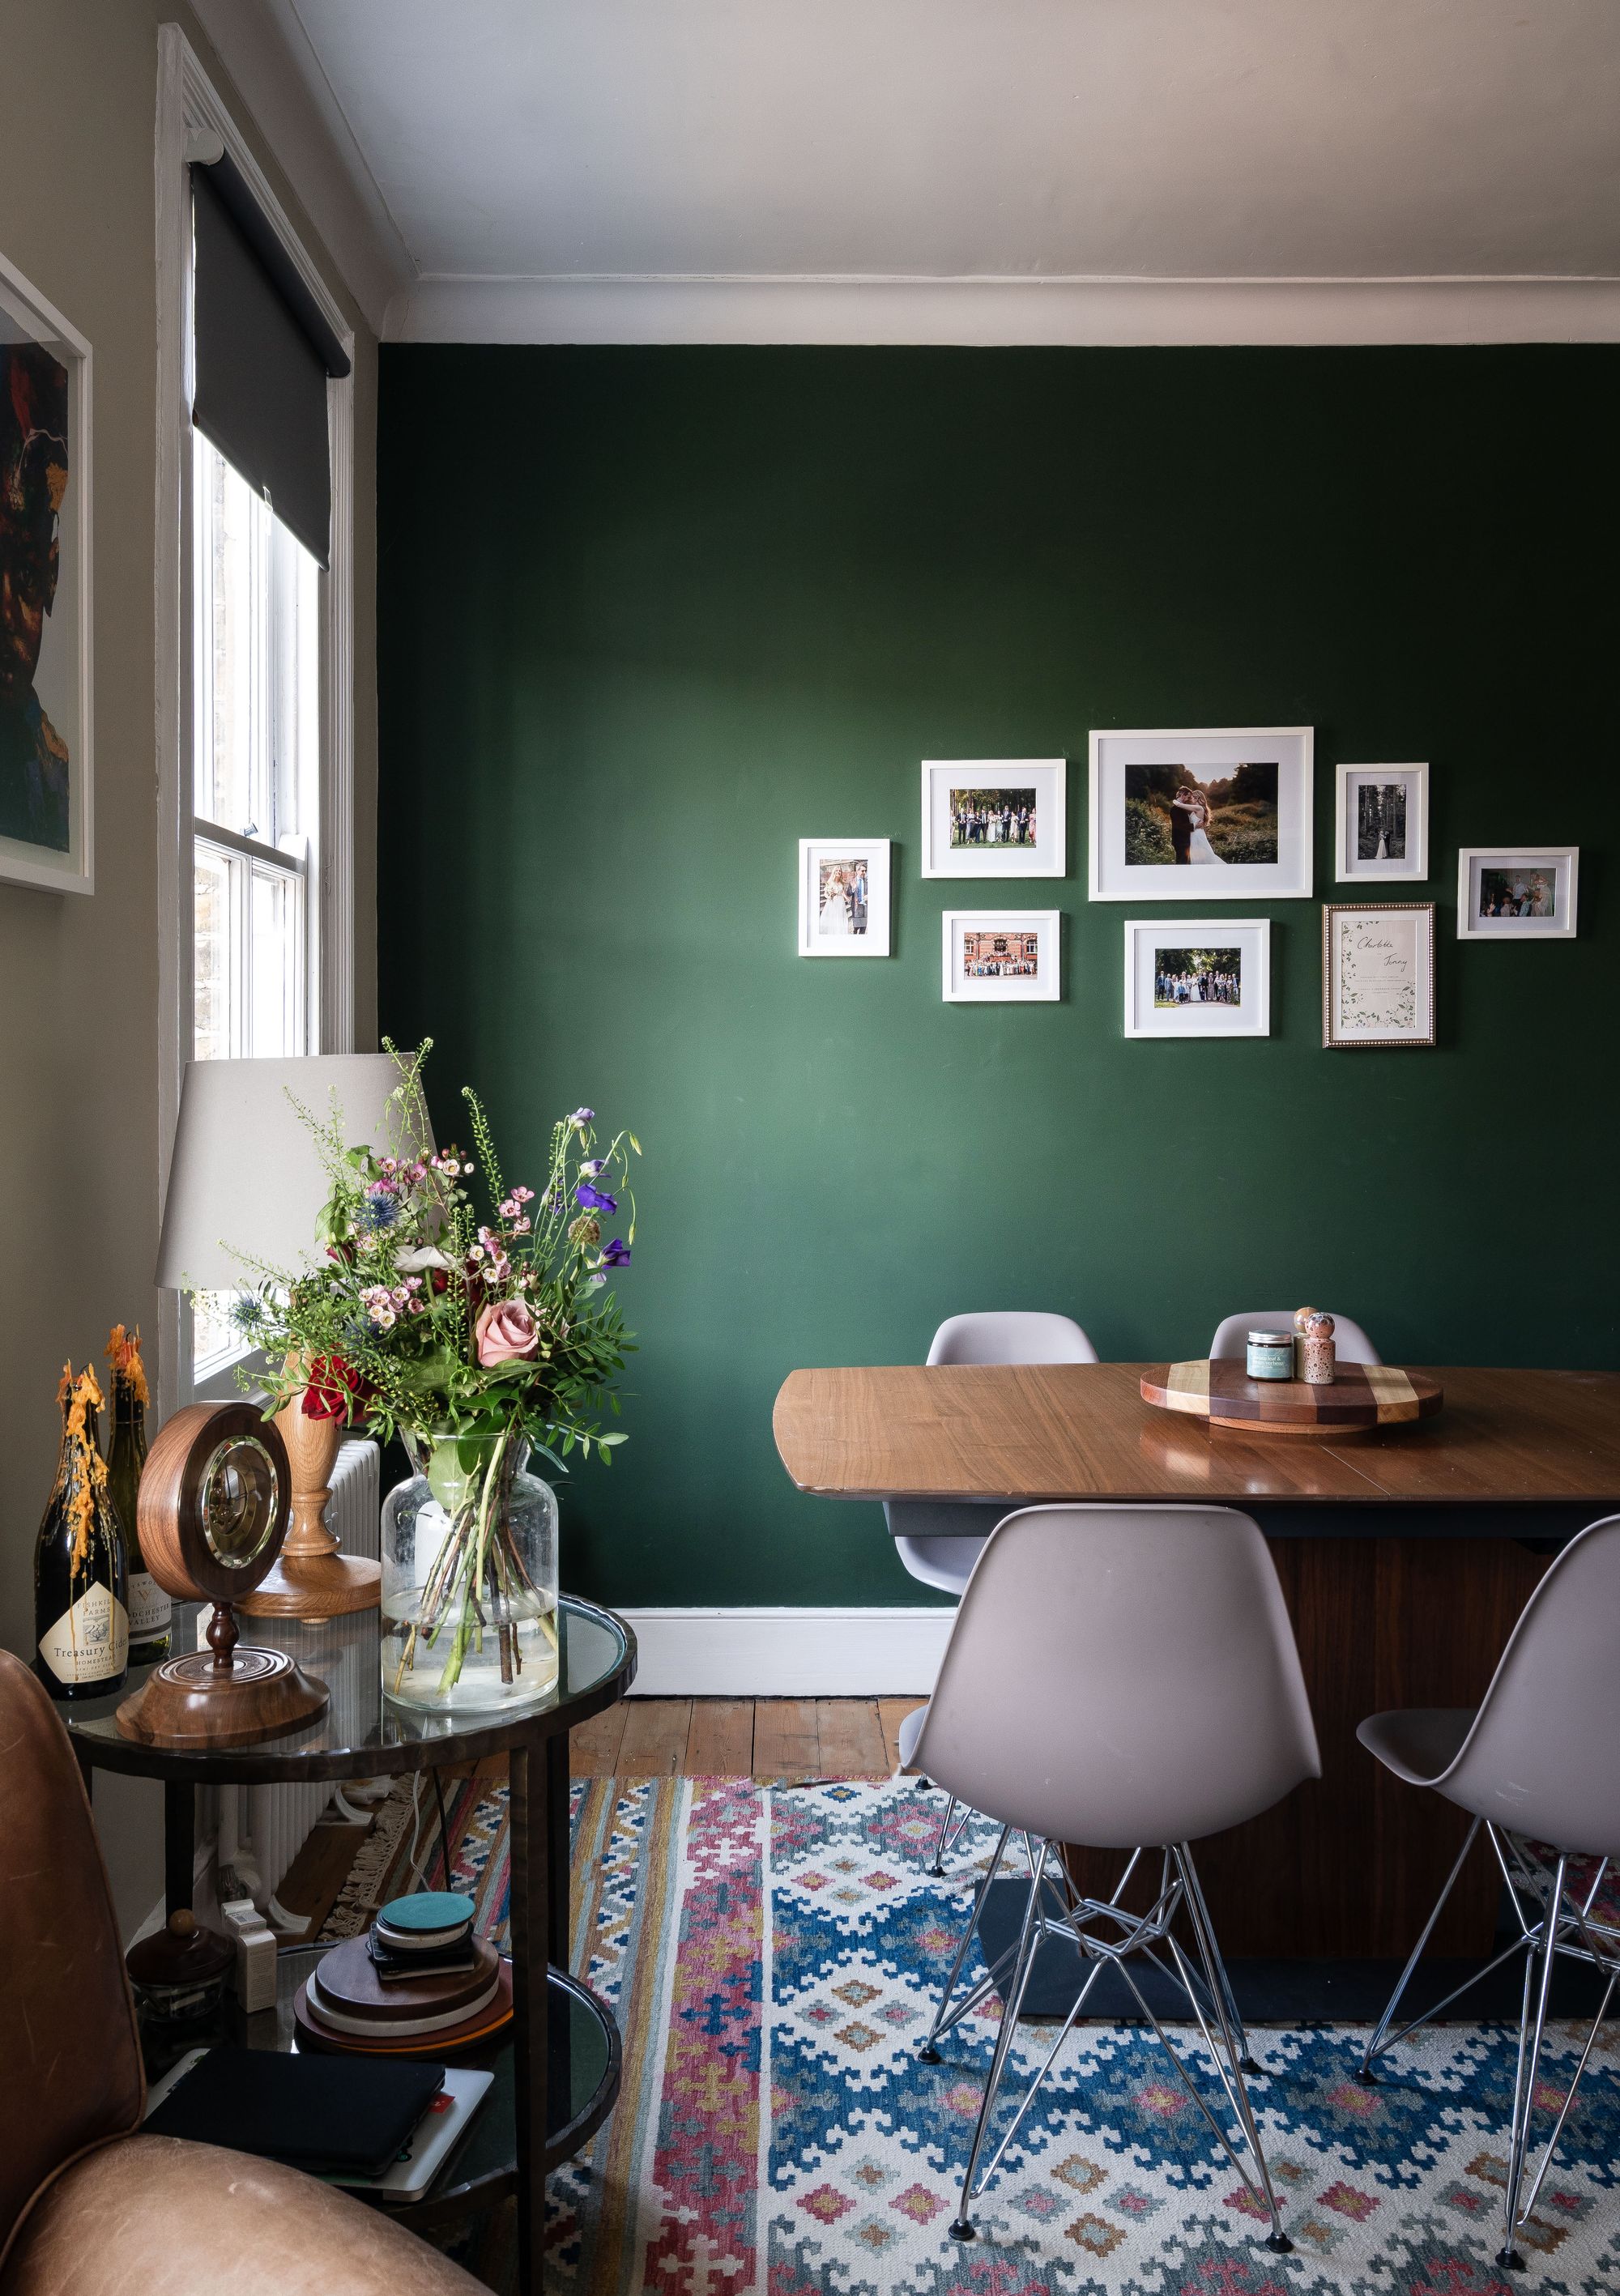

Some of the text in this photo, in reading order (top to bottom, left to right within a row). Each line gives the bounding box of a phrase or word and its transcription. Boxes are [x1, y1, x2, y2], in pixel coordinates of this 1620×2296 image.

[1357, 936, 1393, 950] Charlotte
[77, 1598, 112, 1608] FISHKIL
[128, 1603, 169, 1618] ODCHESTER
[129, 1614, 160, 1625] VALLEY
[53, 1646, 105, 1658] Treasury
[76, 1655, 115, 1666] HOMESTEA
